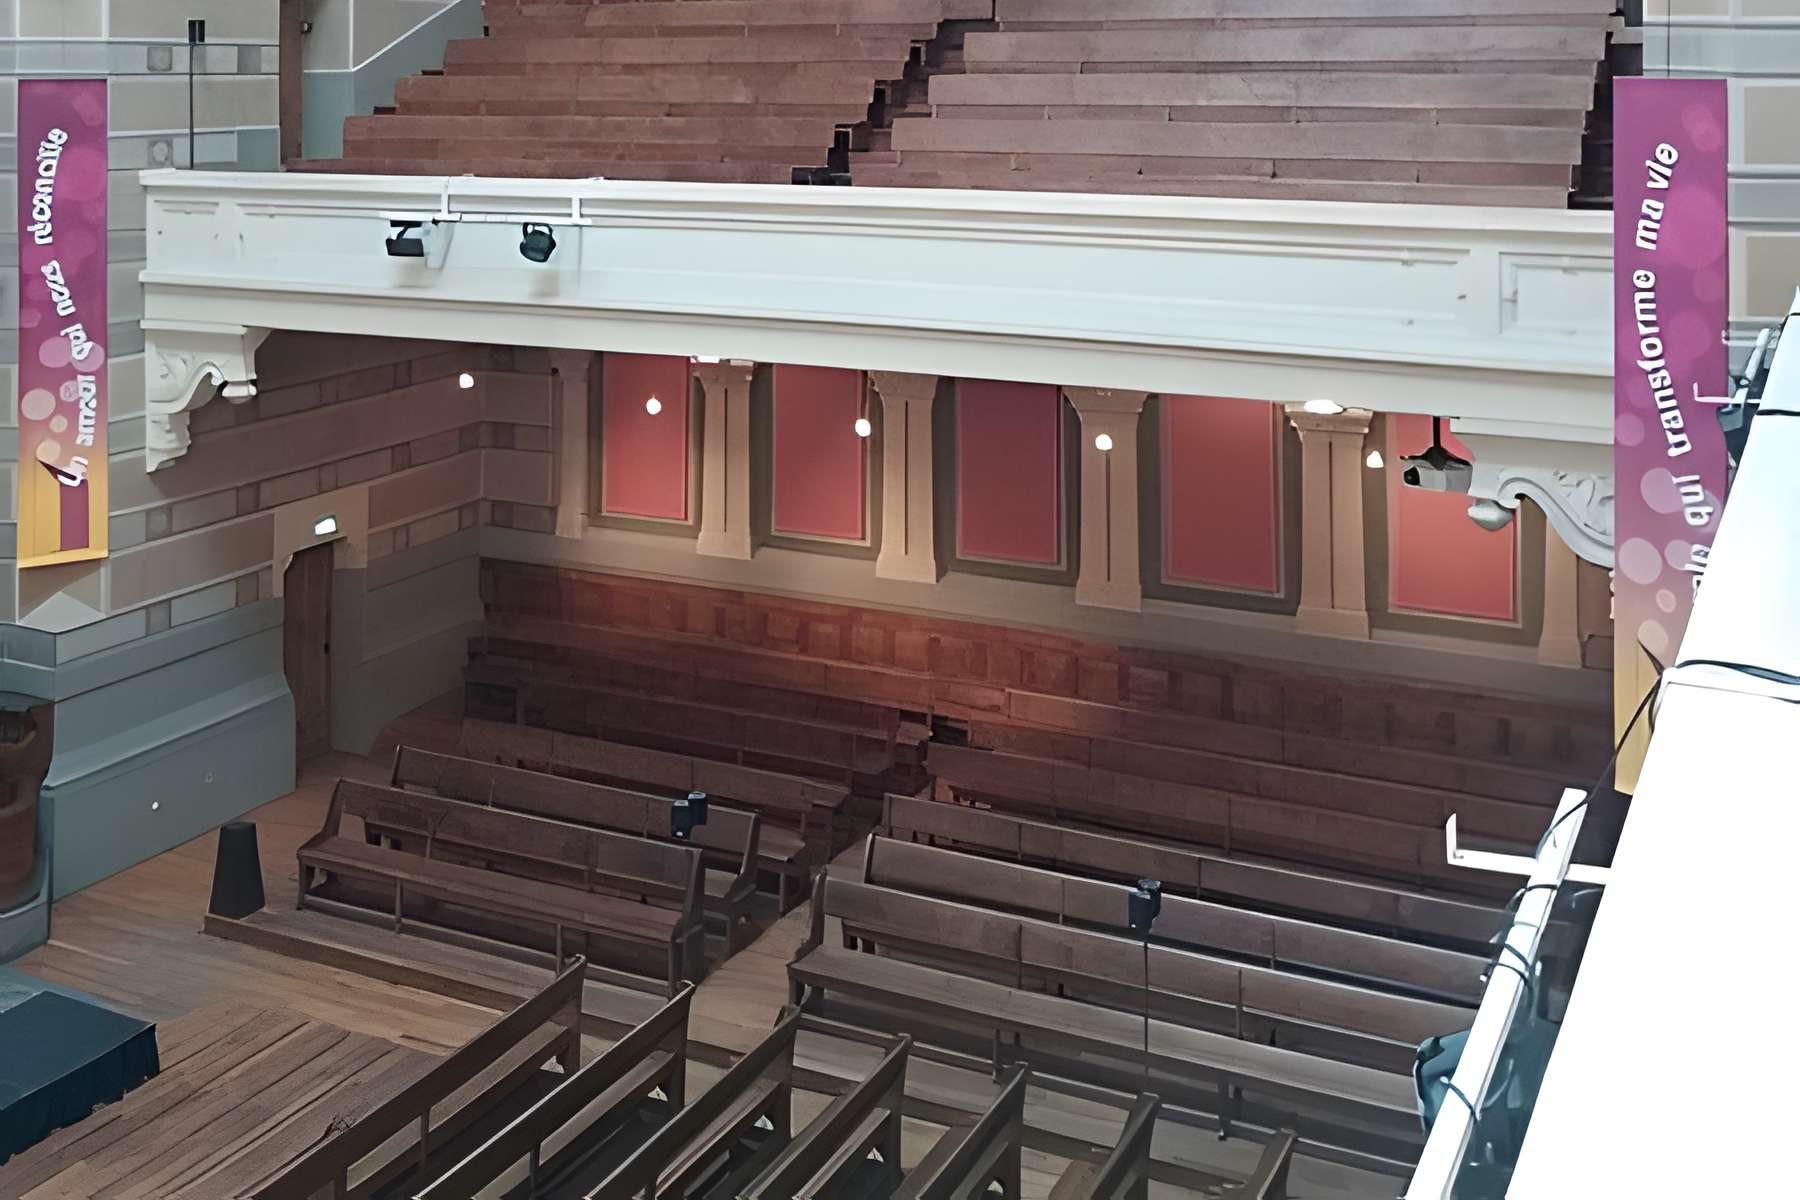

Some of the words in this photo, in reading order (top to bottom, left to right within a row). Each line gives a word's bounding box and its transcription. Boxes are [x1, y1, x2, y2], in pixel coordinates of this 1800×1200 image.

[1645, 143, 1680, 189] vie
[1635, 198, 1665, 250] ma
[1632, 269, 1693, 457] transforme
[1671, 474, 1714, 525] qui
